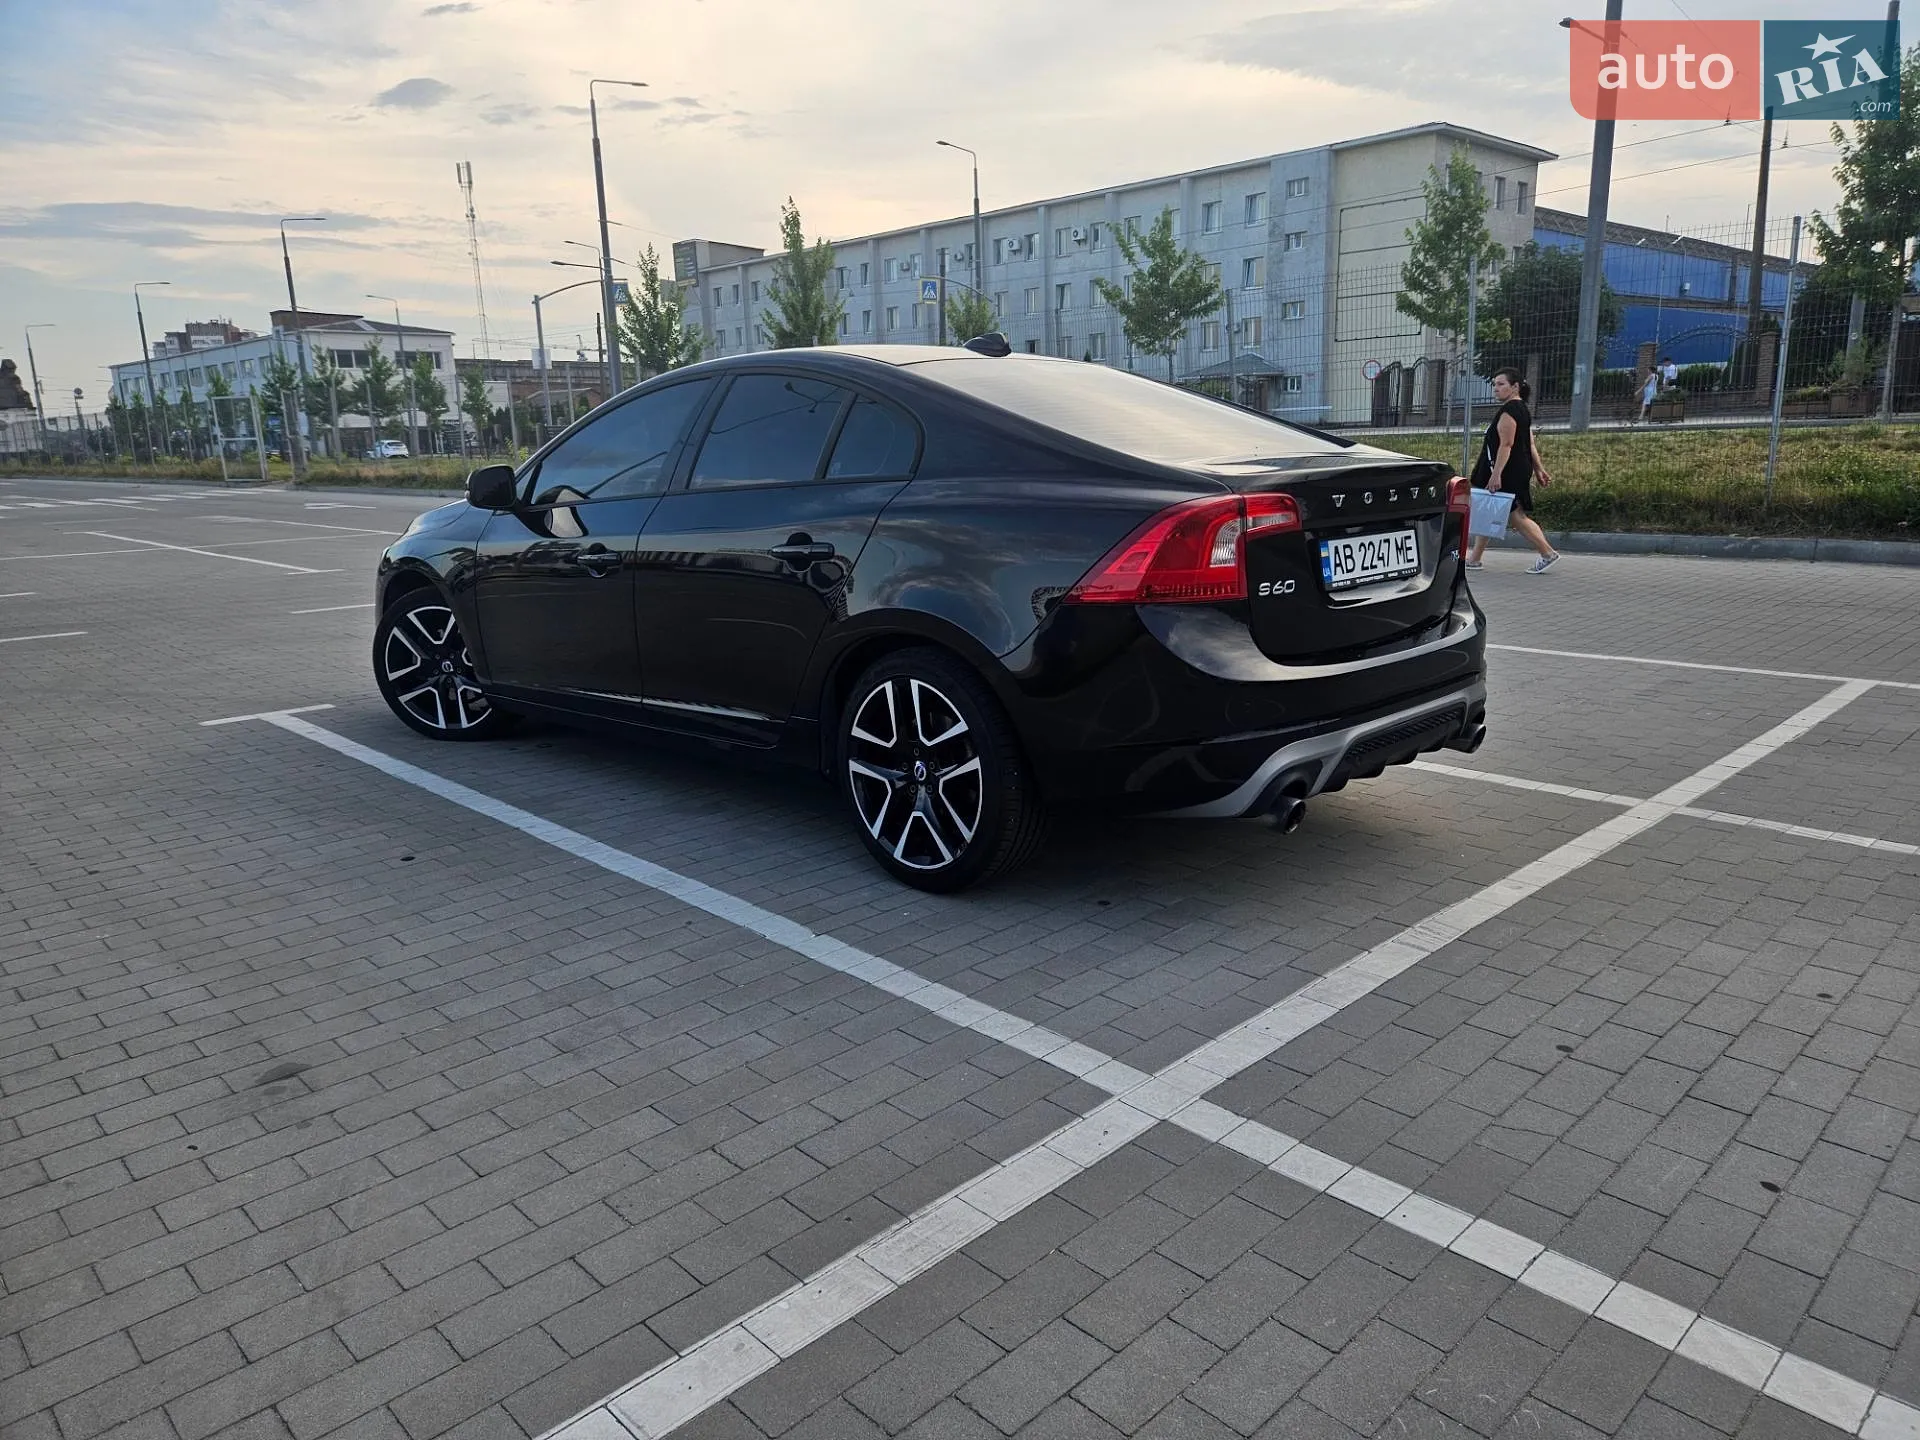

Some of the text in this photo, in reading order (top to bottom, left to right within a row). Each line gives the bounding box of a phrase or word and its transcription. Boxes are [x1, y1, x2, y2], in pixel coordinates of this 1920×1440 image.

[1331, 486, 1436, 508] VOLVO
[1333, 535, 1415, 576] AB 2247 ME
[1258, 580, 1296, 596] S60
